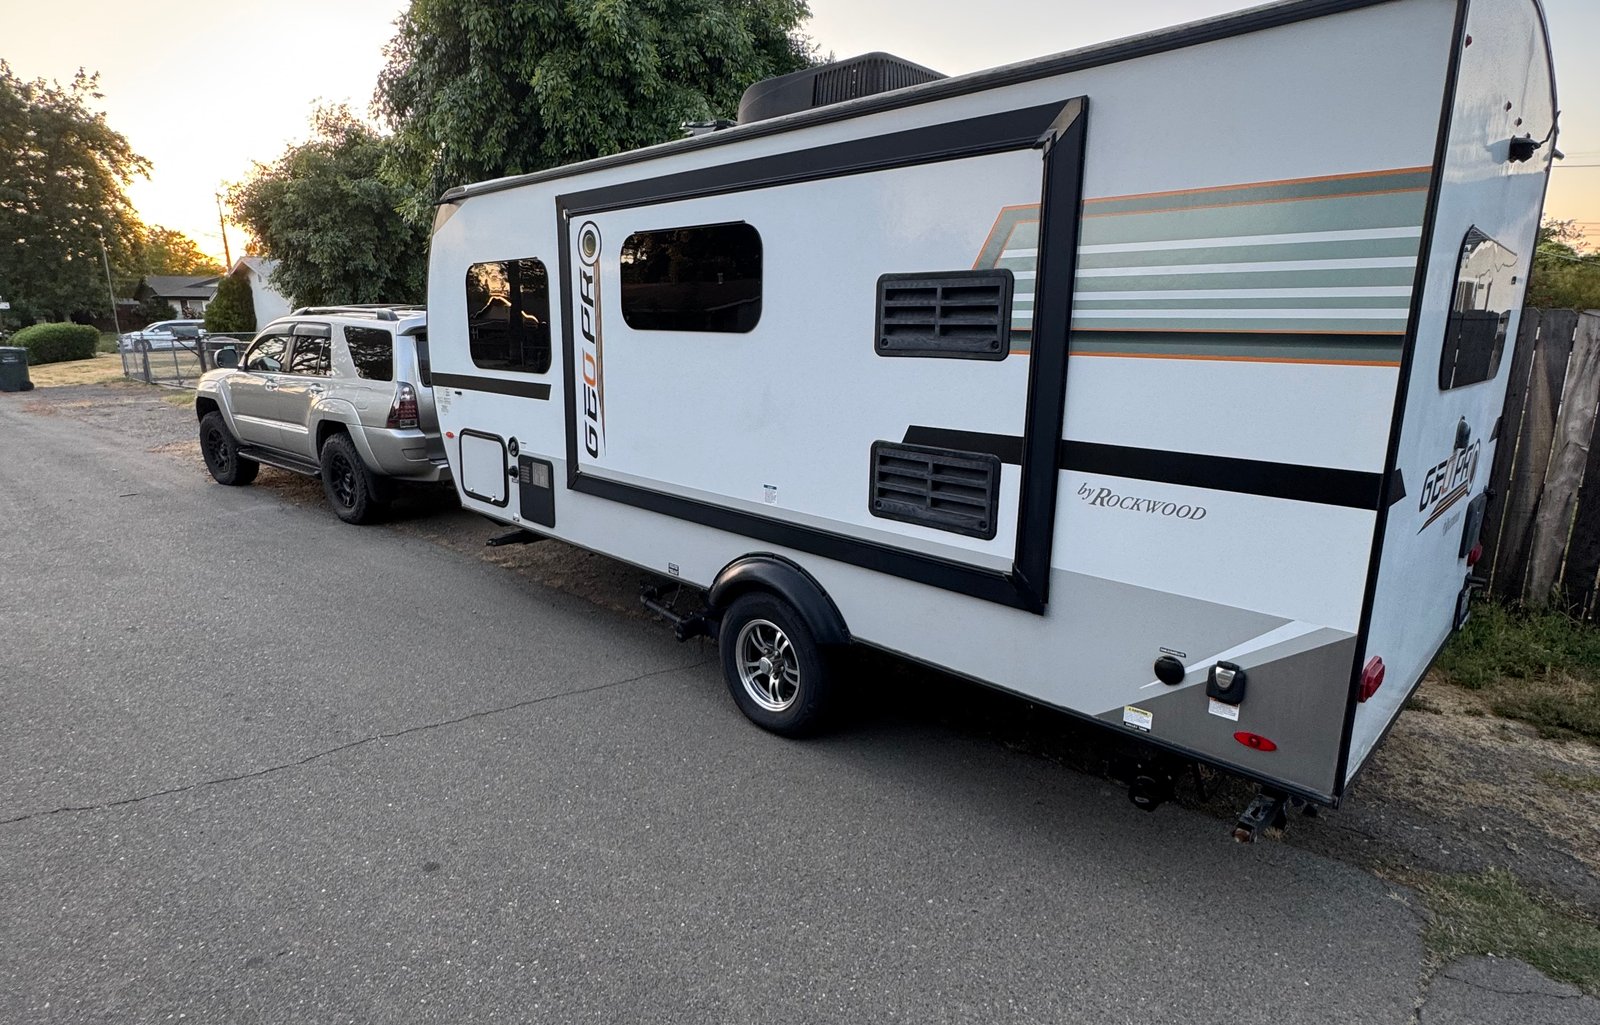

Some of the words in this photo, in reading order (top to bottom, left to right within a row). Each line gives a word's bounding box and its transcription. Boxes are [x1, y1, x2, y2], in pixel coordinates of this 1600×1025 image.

[577, 220, 602, 345] PRO
[582, 347, 599, 460] GEO
[1077, 482, 1096, 500] by
[1089, 487, 1207, 520] ROCKWOOD
[1419, 453, 1458, 513] GEO
